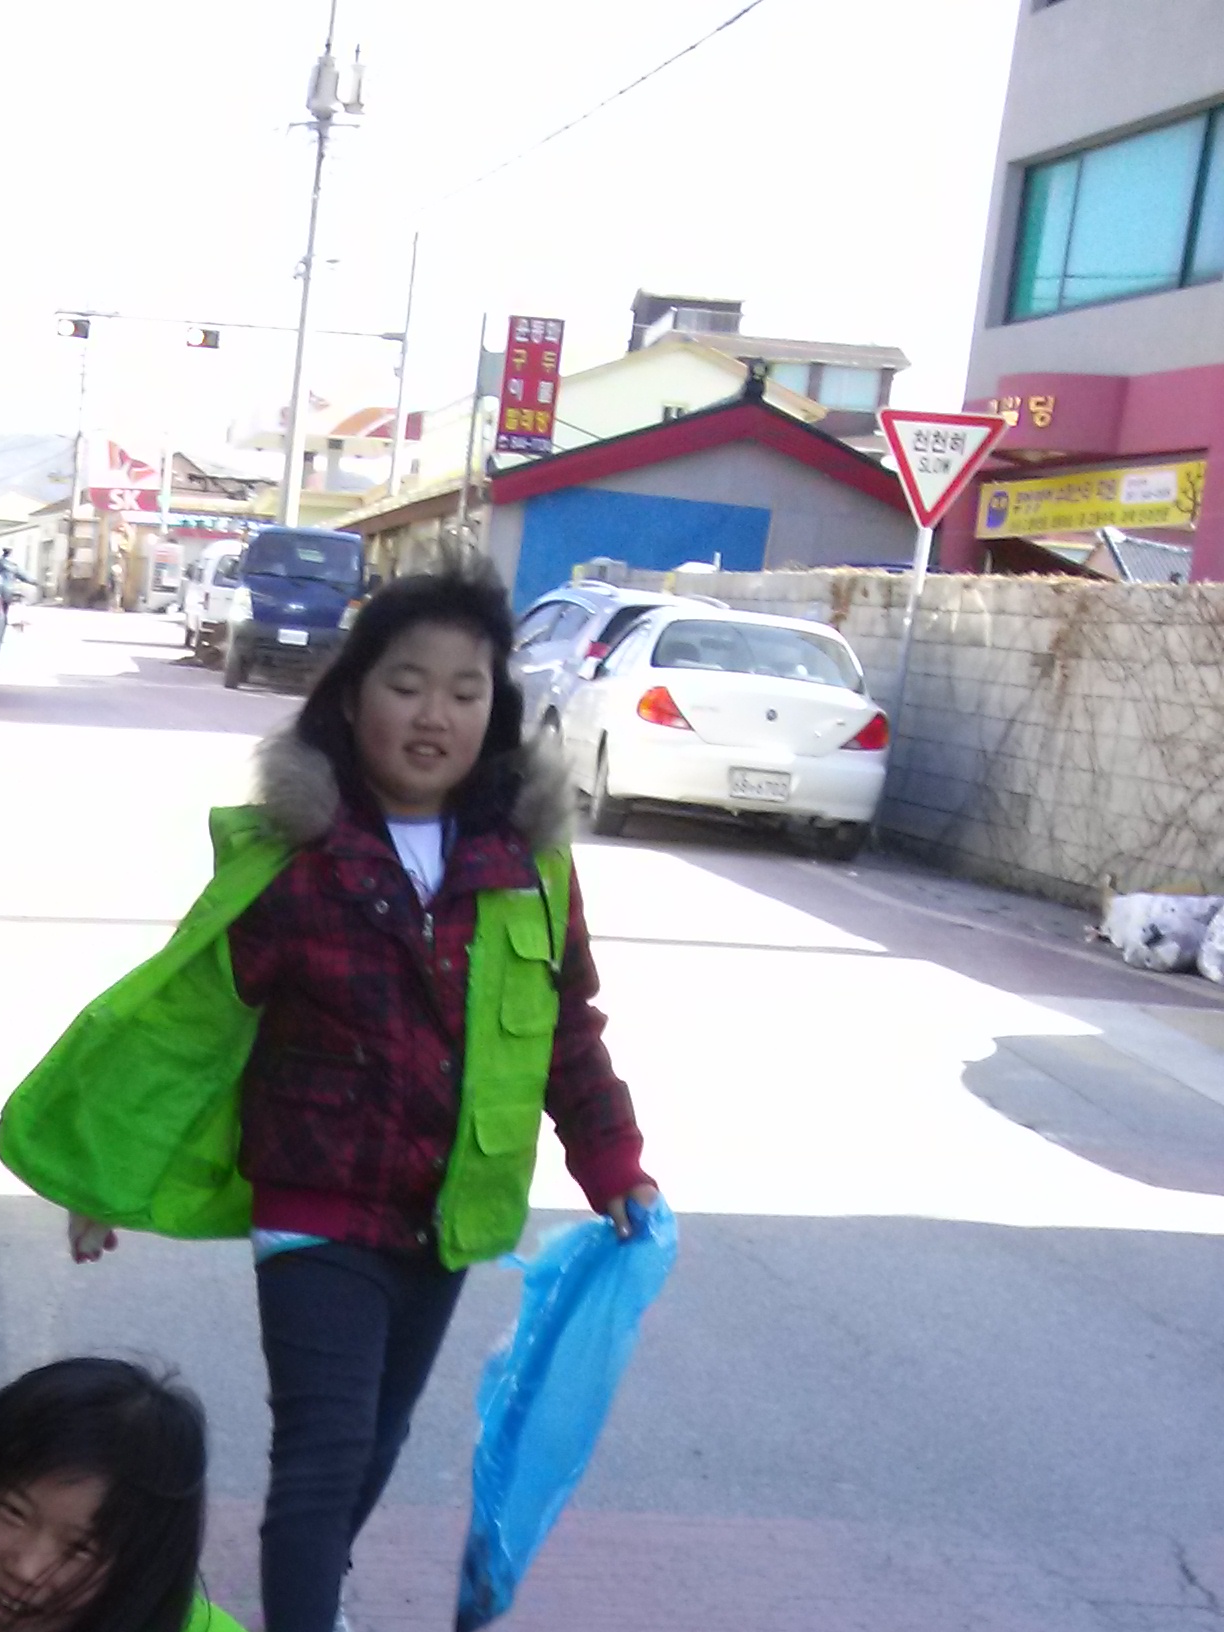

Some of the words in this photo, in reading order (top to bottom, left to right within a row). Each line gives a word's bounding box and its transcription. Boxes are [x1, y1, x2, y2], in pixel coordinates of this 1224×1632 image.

[912, 430, 966, 456] 천천히
[918, 456, 952, 475] SLOW
[108, 488, 142, 511] SK
